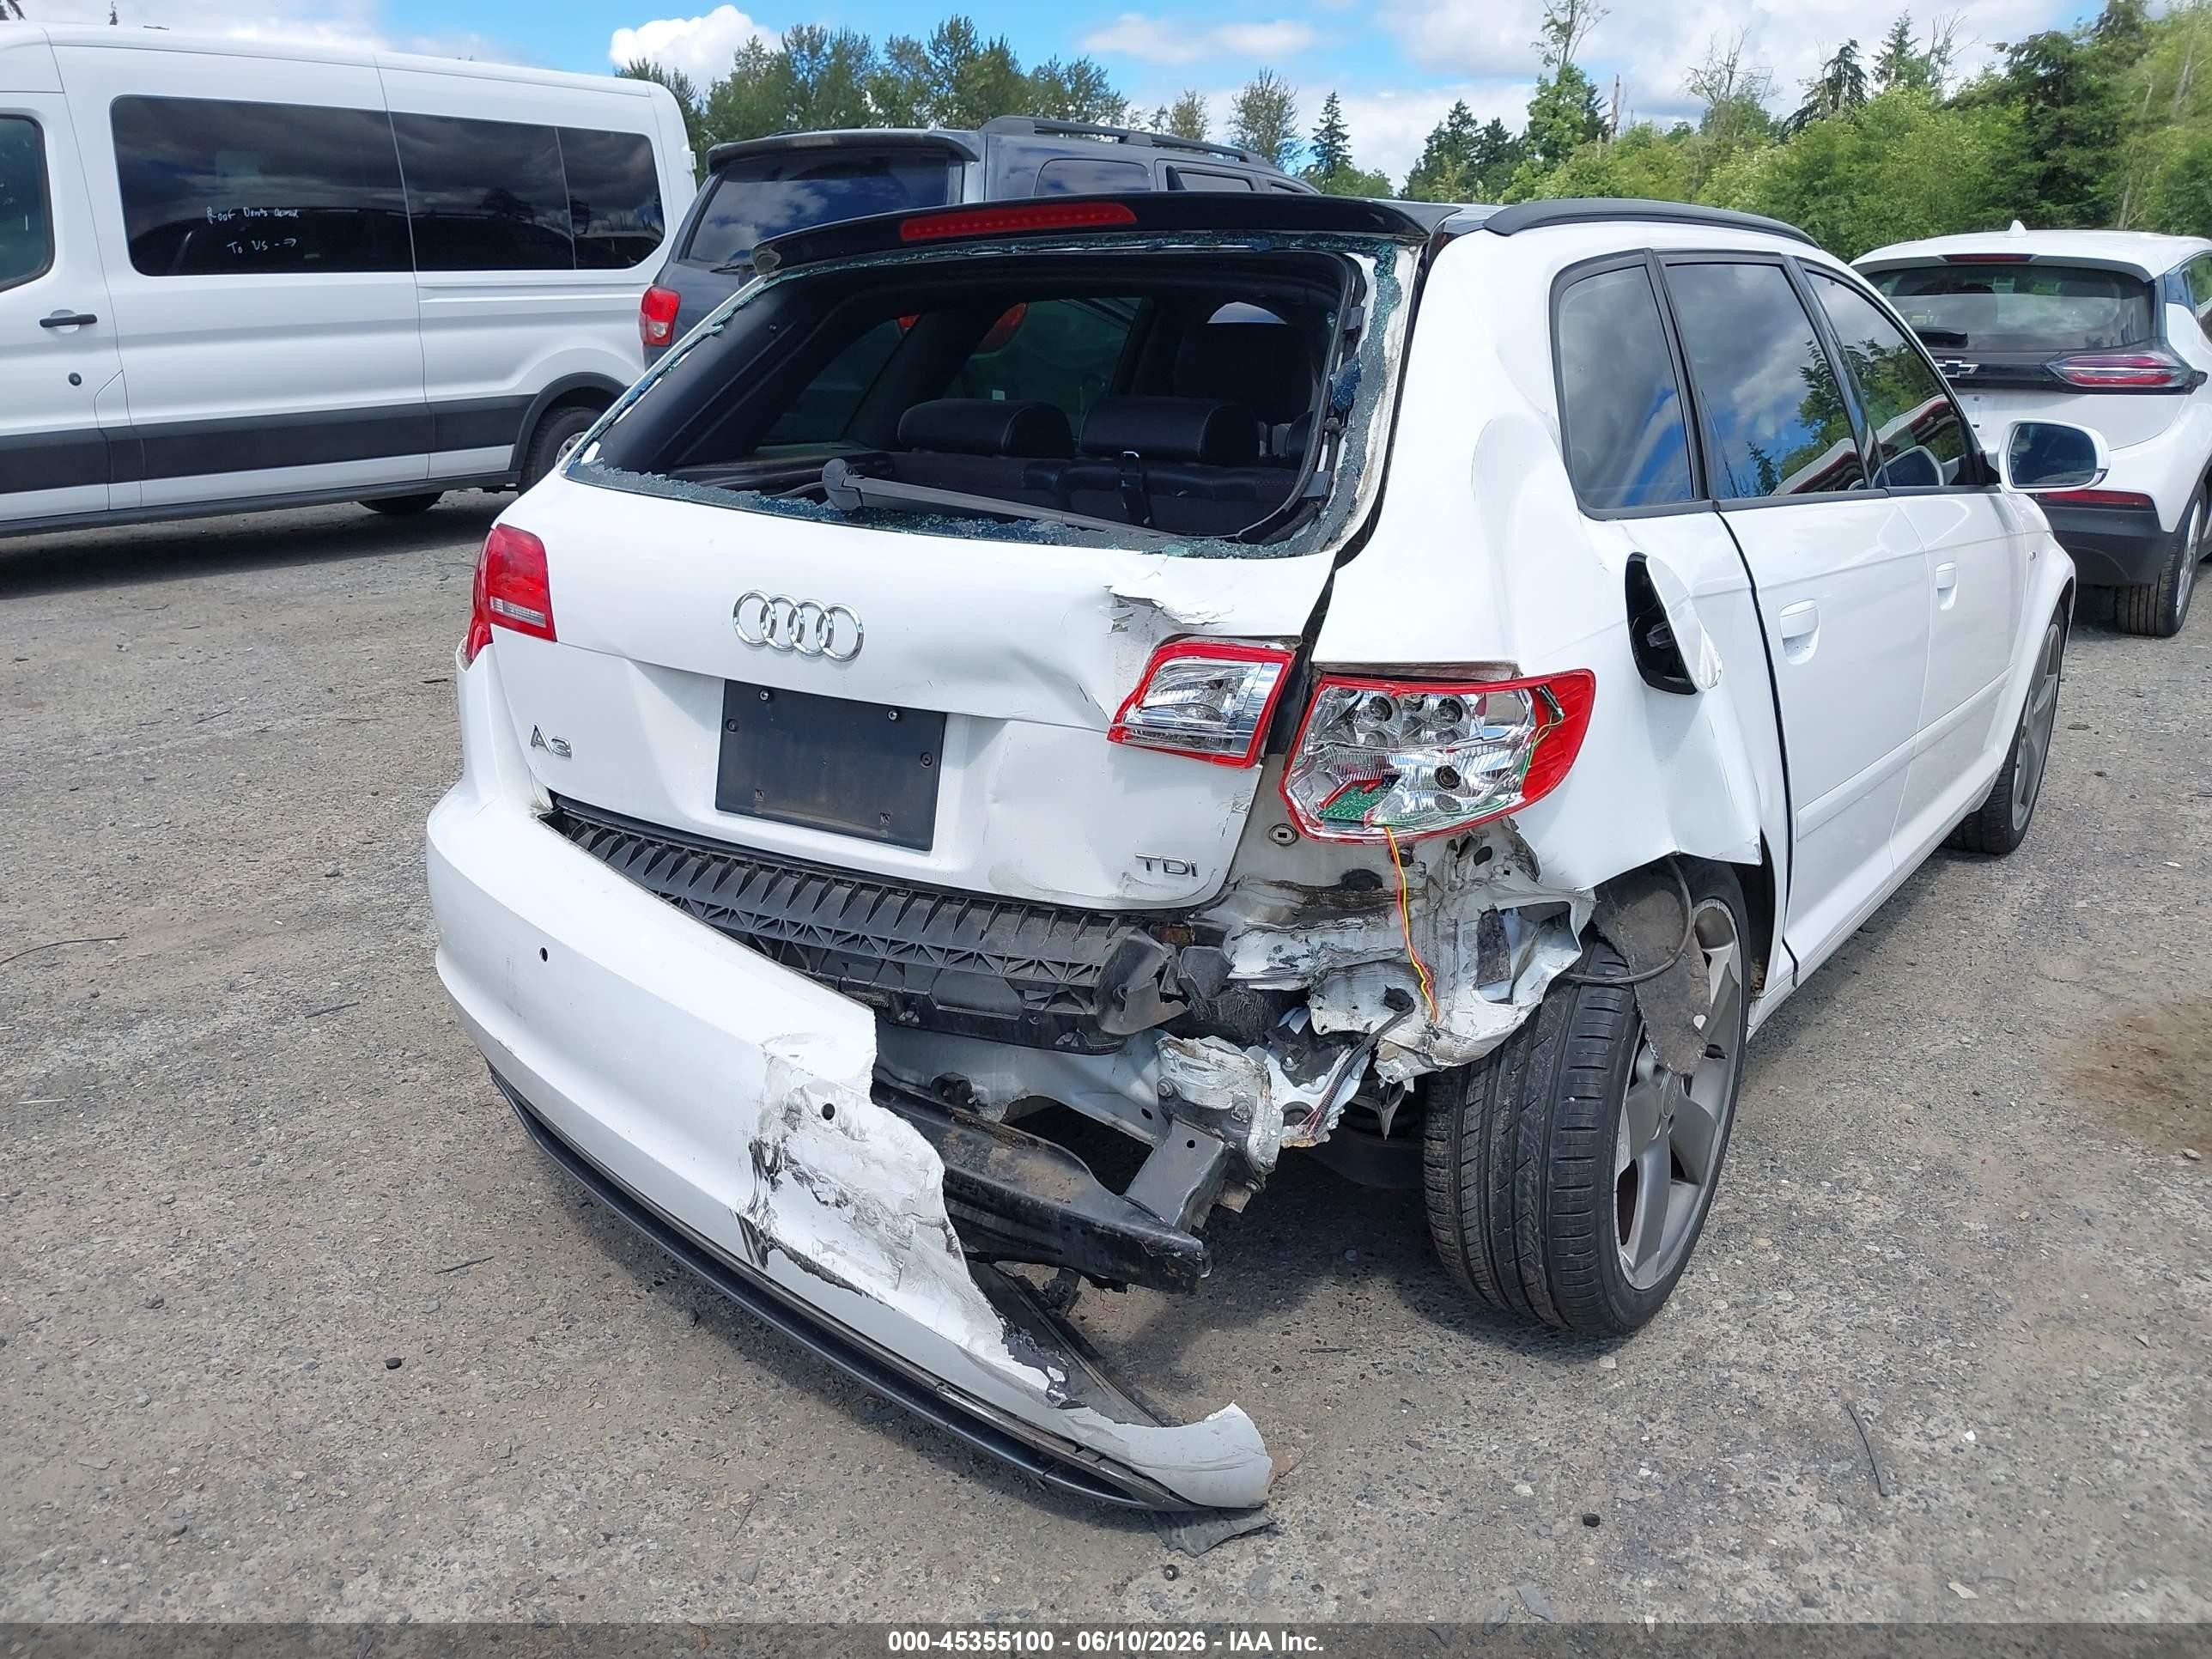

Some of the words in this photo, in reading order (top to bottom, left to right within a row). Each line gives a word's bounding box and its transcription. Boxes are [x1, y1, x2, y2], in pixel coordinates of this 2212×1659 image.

[227, 241, 243, 254] To
[530, 723, 573, 758] A3
[1134, 852, 1199, 878] TDI
